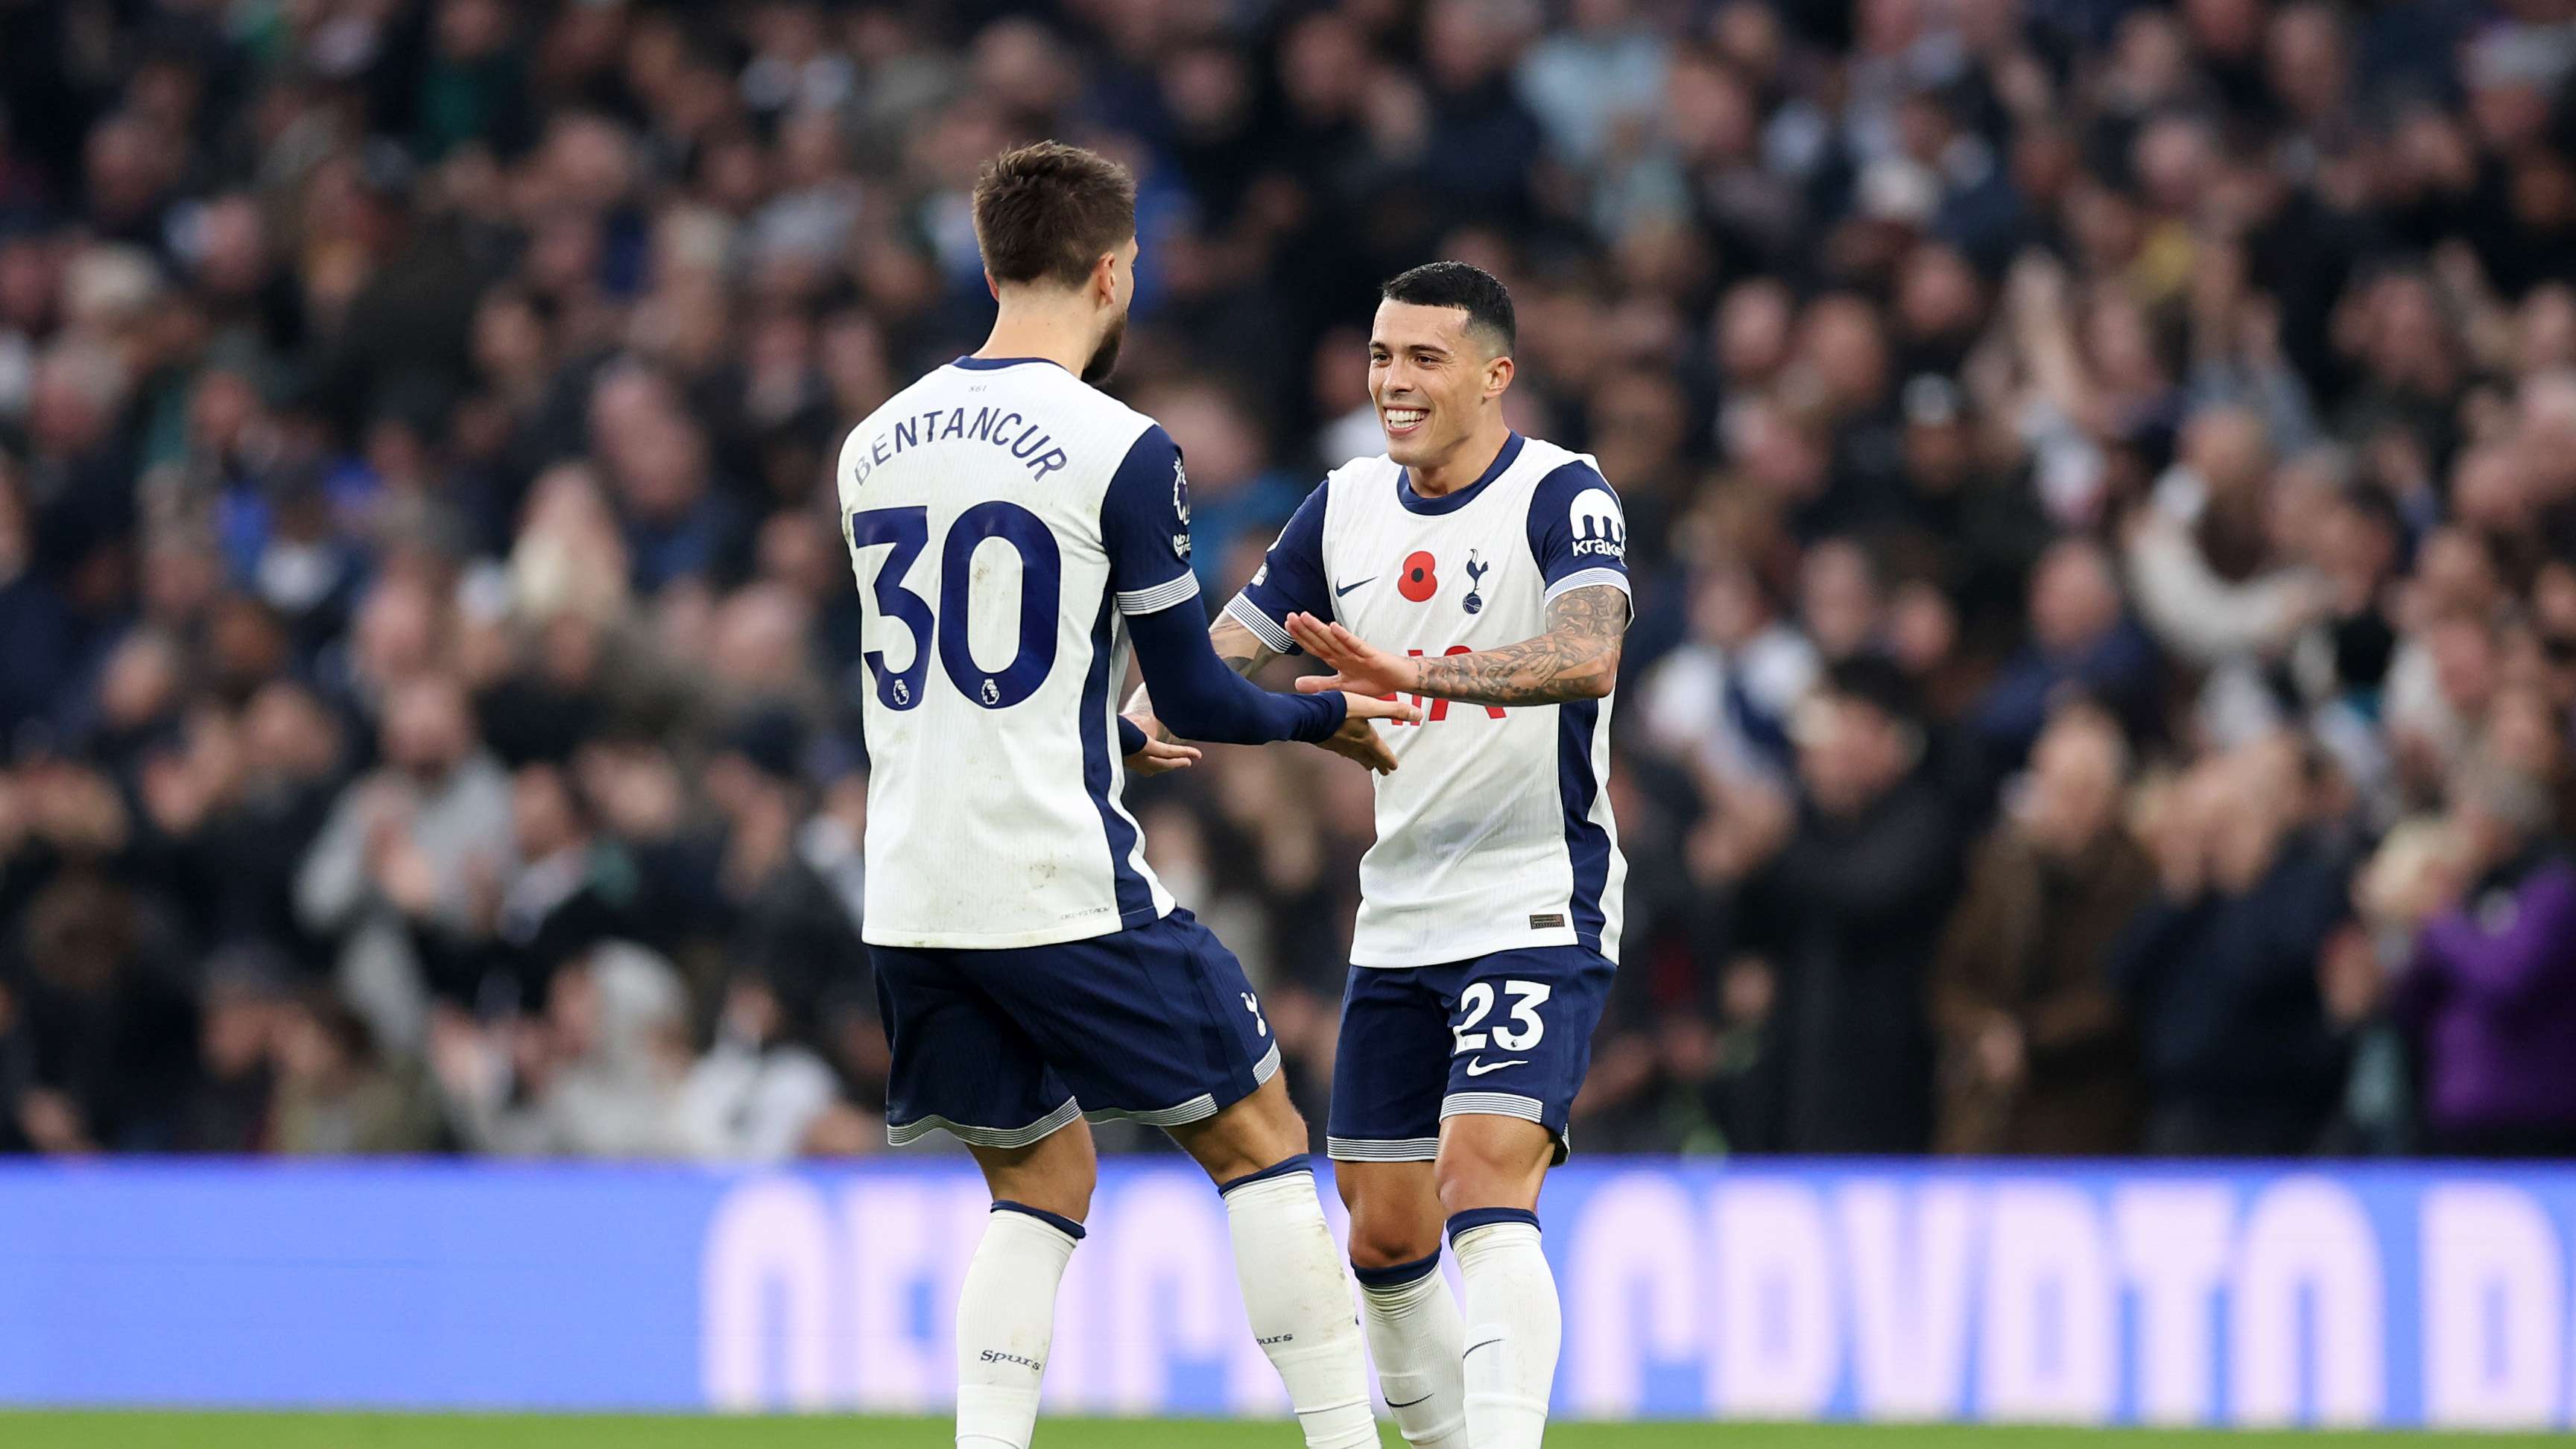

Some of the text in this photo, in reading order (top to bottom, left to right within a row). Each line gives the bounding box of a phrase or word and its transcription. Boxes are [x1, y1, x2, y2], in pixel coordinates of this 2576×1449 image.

[855, 407, 1067, 486] BENTANCUR
[1572, 539, 1627, 569] krake
[852, 500, 1061, 711] 30
[1453, 980, 1551, 1055] 23
[980, 1350, 1041, 1371] Spurs
